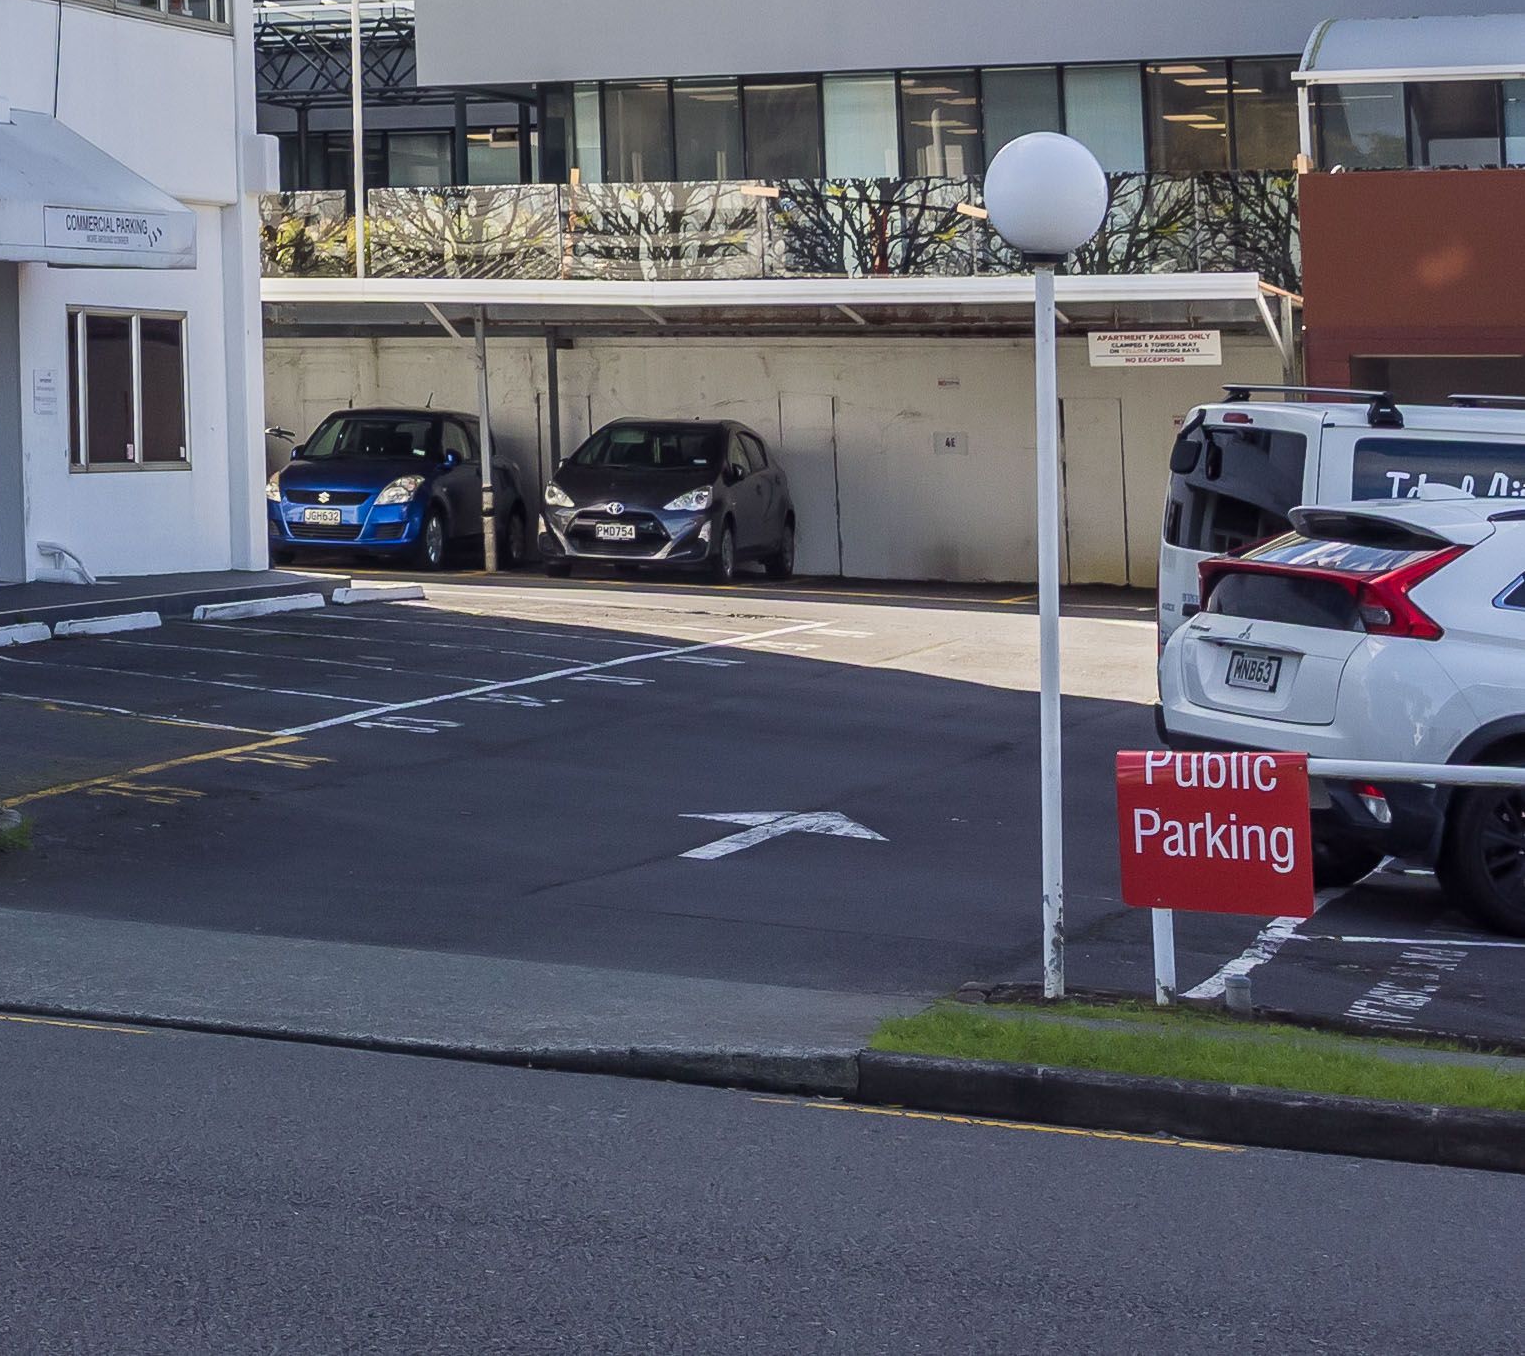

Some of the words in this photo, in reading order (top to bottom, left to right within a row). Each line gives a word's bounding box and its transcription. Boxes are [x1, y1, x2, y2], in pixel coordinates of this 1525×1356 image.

[65, 214, 115, 233] COMMERCIAL
[116, 217, 148, 235] PARKING
[1148, 333, 1185, 341] PARKING
[945, 437, 955, 447] 4E
[306, 509, 340, 523] JGH632
[1233, 655, 1273, 684] MNB63
[1145, 750, 1278, 791] Public
[1134, 807, 1295, 873] Parking
